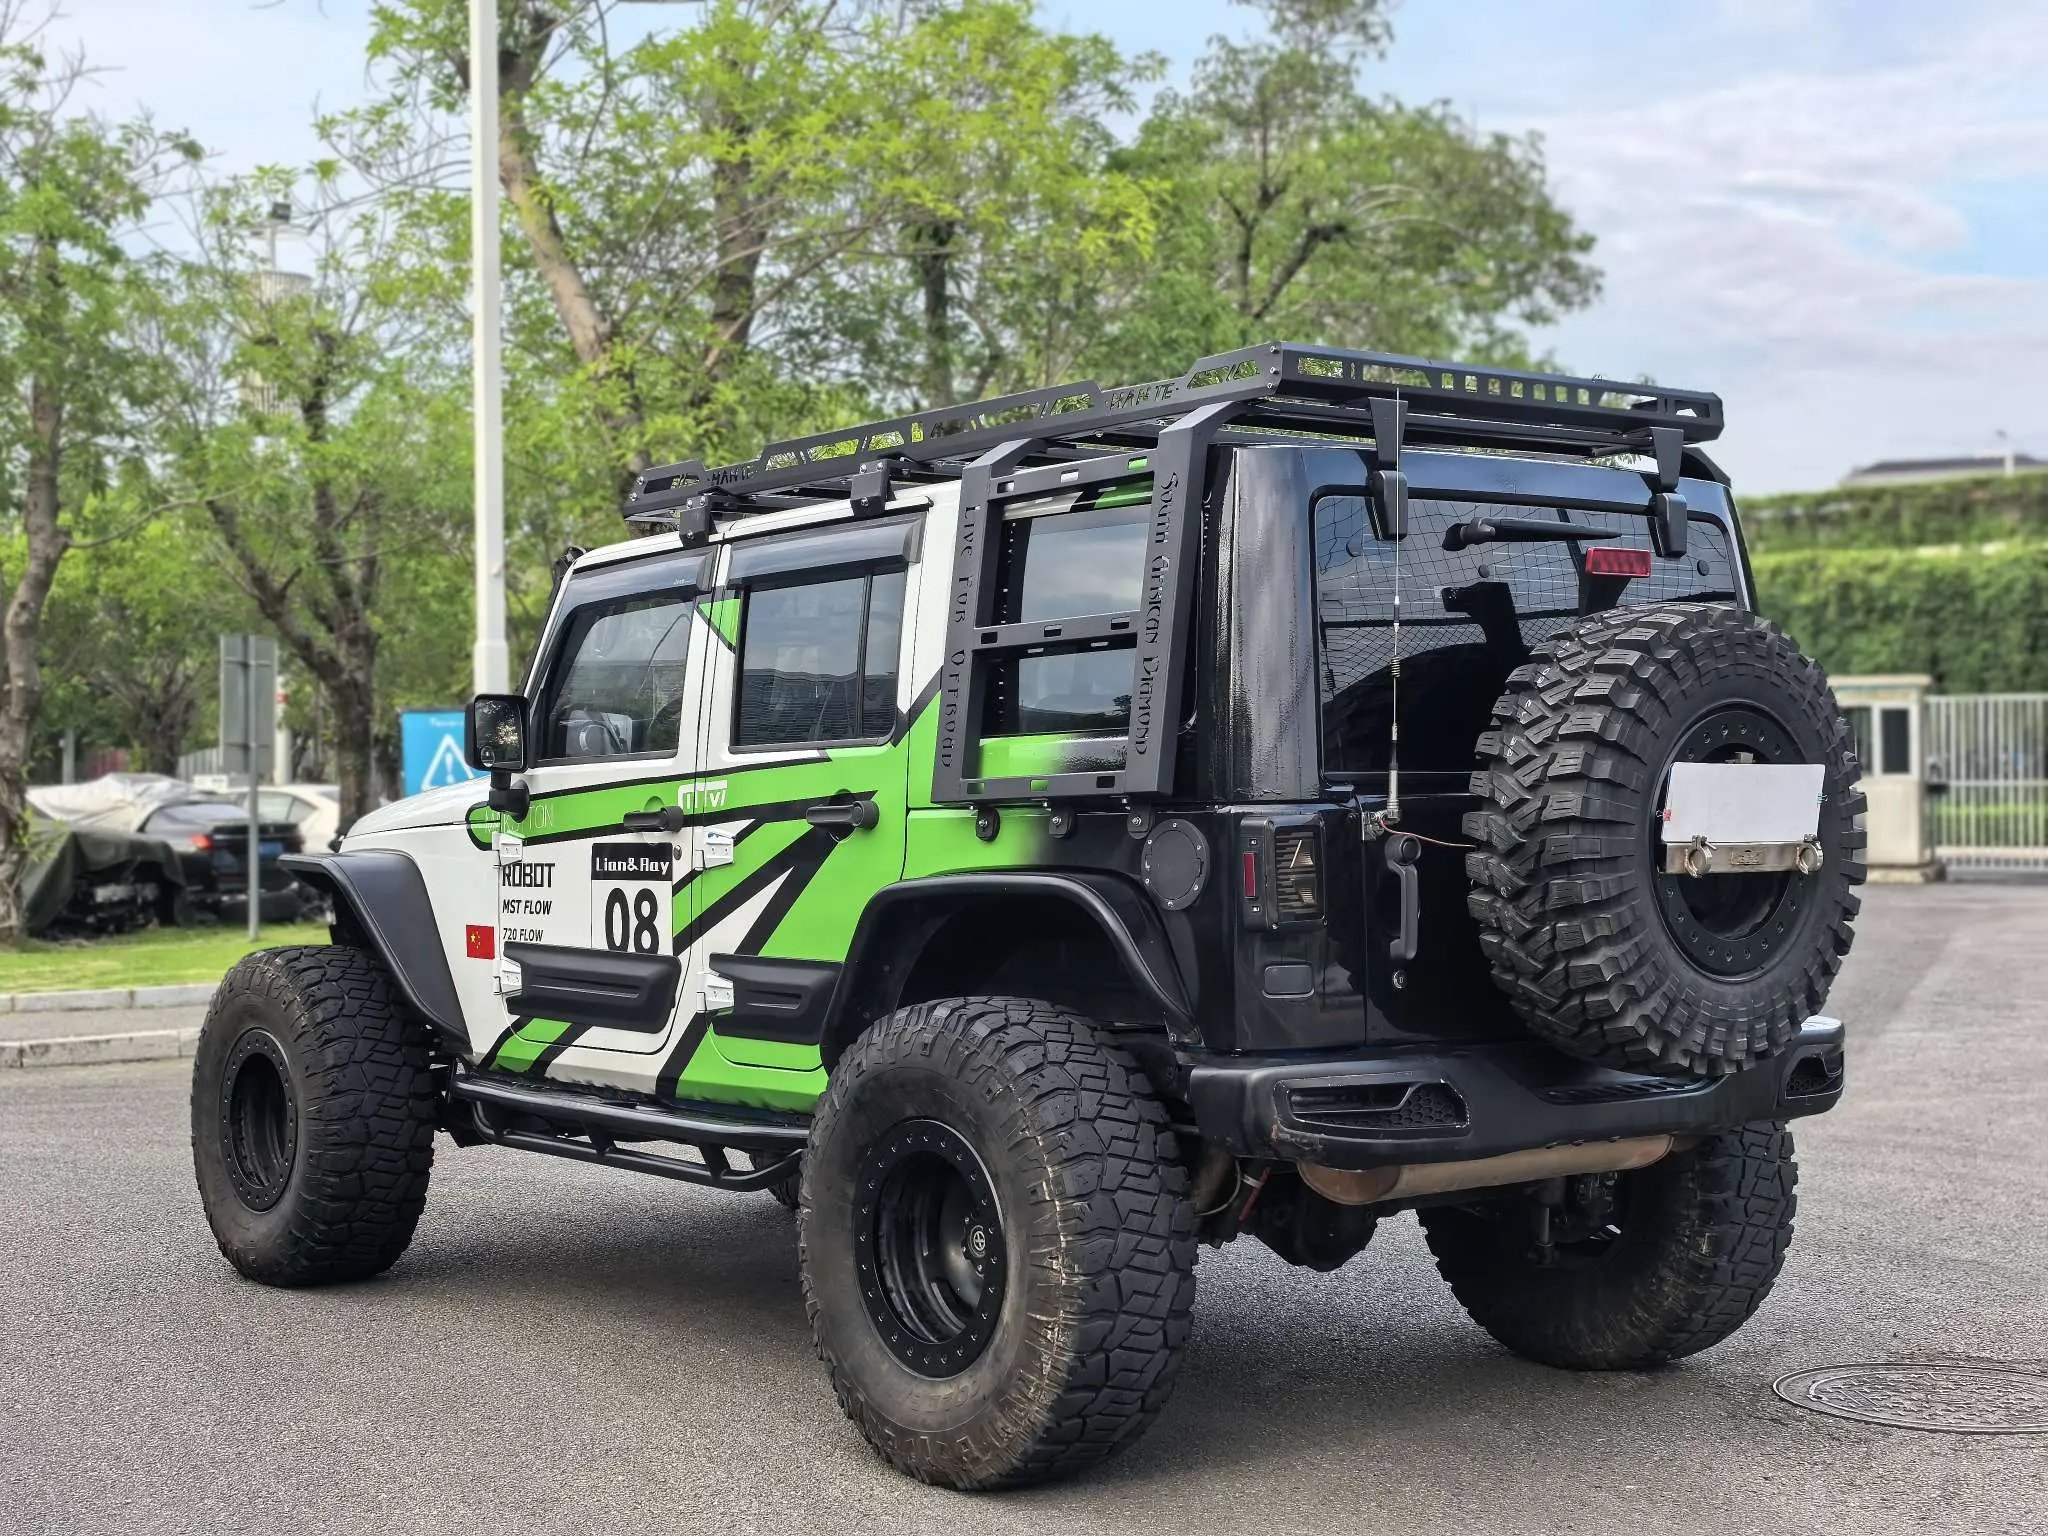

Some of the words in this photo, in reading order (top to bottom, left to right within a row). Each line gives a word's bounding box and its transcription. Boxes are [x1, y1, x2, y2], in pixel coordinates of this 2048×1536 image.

[502, 862, 556, 888] ROBOT
[502, 898, 522, 914] MST
[523, 899, 553, 915] FLOW
[605, 887, 660, 955] 08
[503, 927, 518, 941] 720
[519, 928, 544, 942] FLOW
